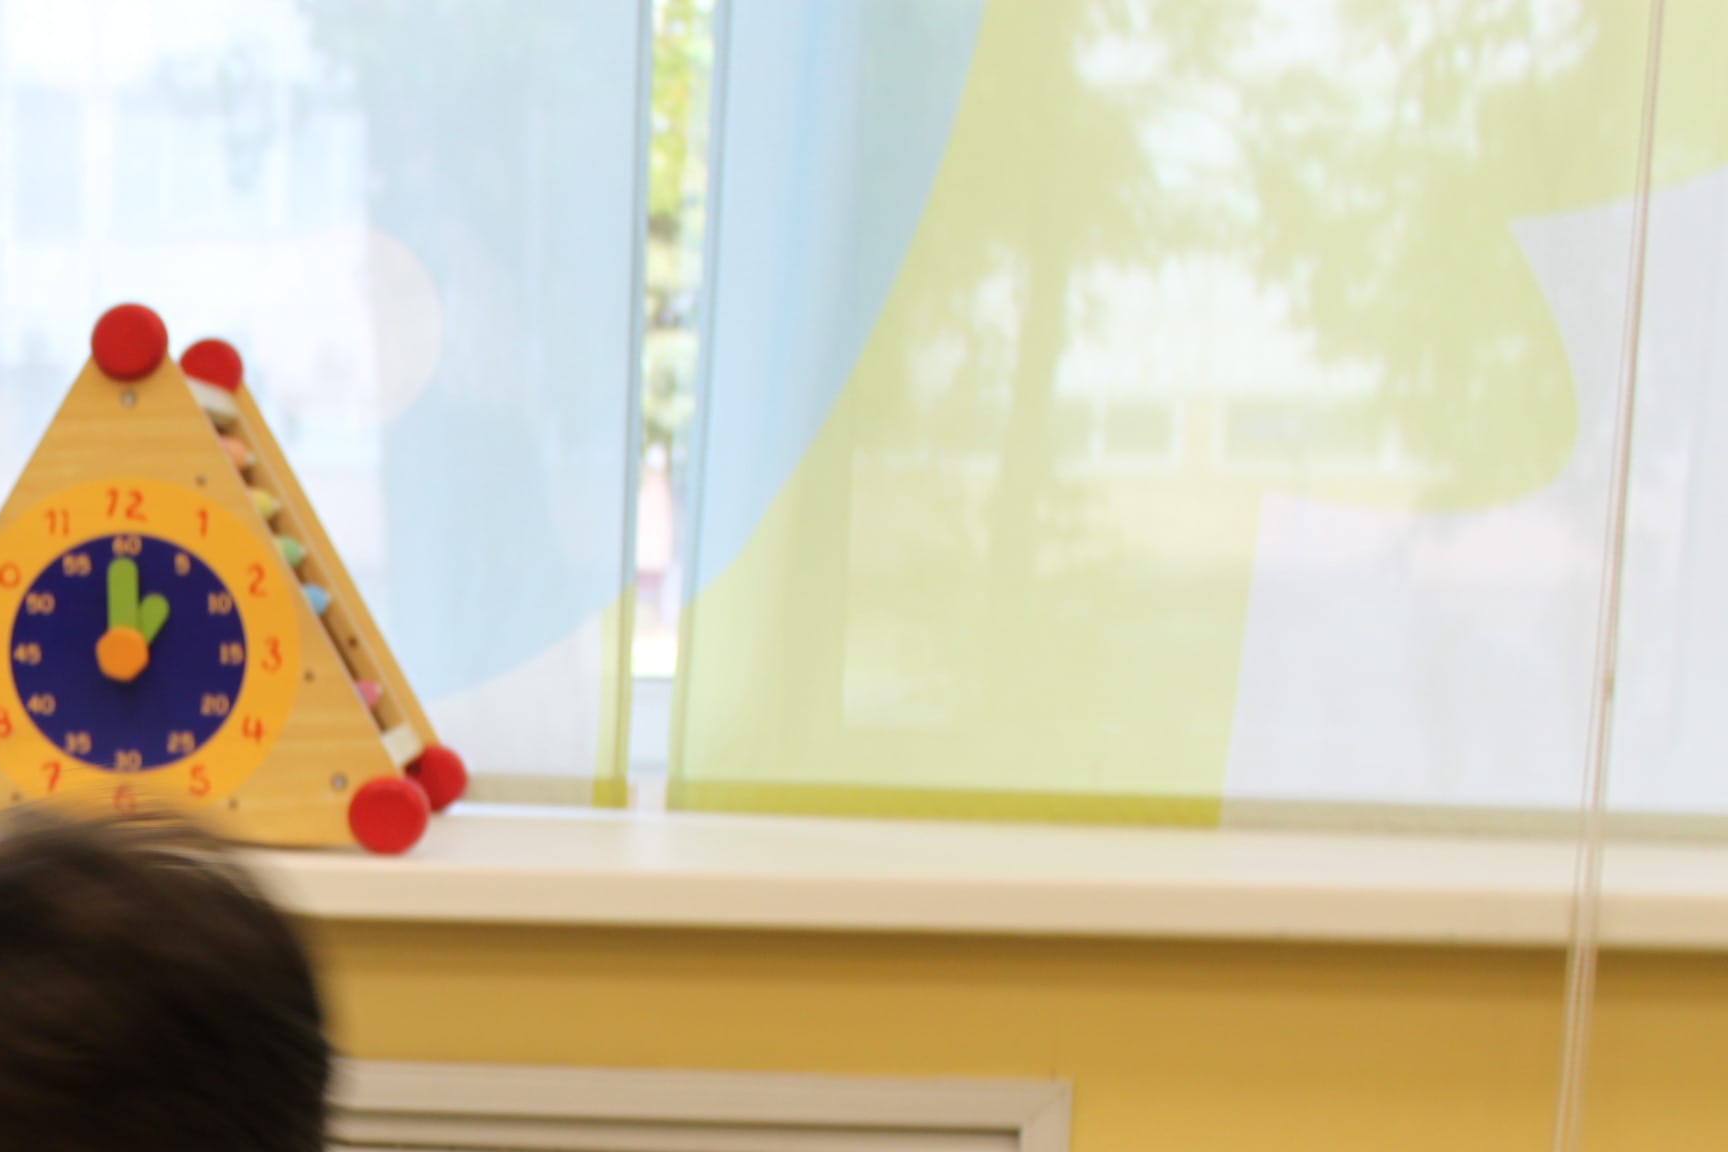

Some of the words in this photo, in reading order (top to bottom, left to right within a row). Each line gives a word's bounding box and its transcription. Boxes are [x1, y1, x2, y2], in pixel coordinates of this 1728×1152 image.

[106, 487, 147, 523] 12
[44, 508, 71, 536] 11
[197, 508, 210, 539] 1
[112, 535, 144, 556] 60
[62, 553, 92, 577] 55
[174, 552, 191, 576] 5
[247, 563, 267, 598] 2
[25, 592, 56, 615] 50
[207, 592, 233, 615] 10
[13, 643, 42, 666] 45
[219, 643, 244, 666] 15
[260, 635, 283, 673] 3
[27, 693, 56, 716] 40
[200, 693, 230, 716] 20
[241, 715, 265, 744] 4
[65, 731, 92, 754] 35
[114, 749, 143, 772] 30
[41, 761, 62, 793] 7
[189, 764, 212, 798] 5
